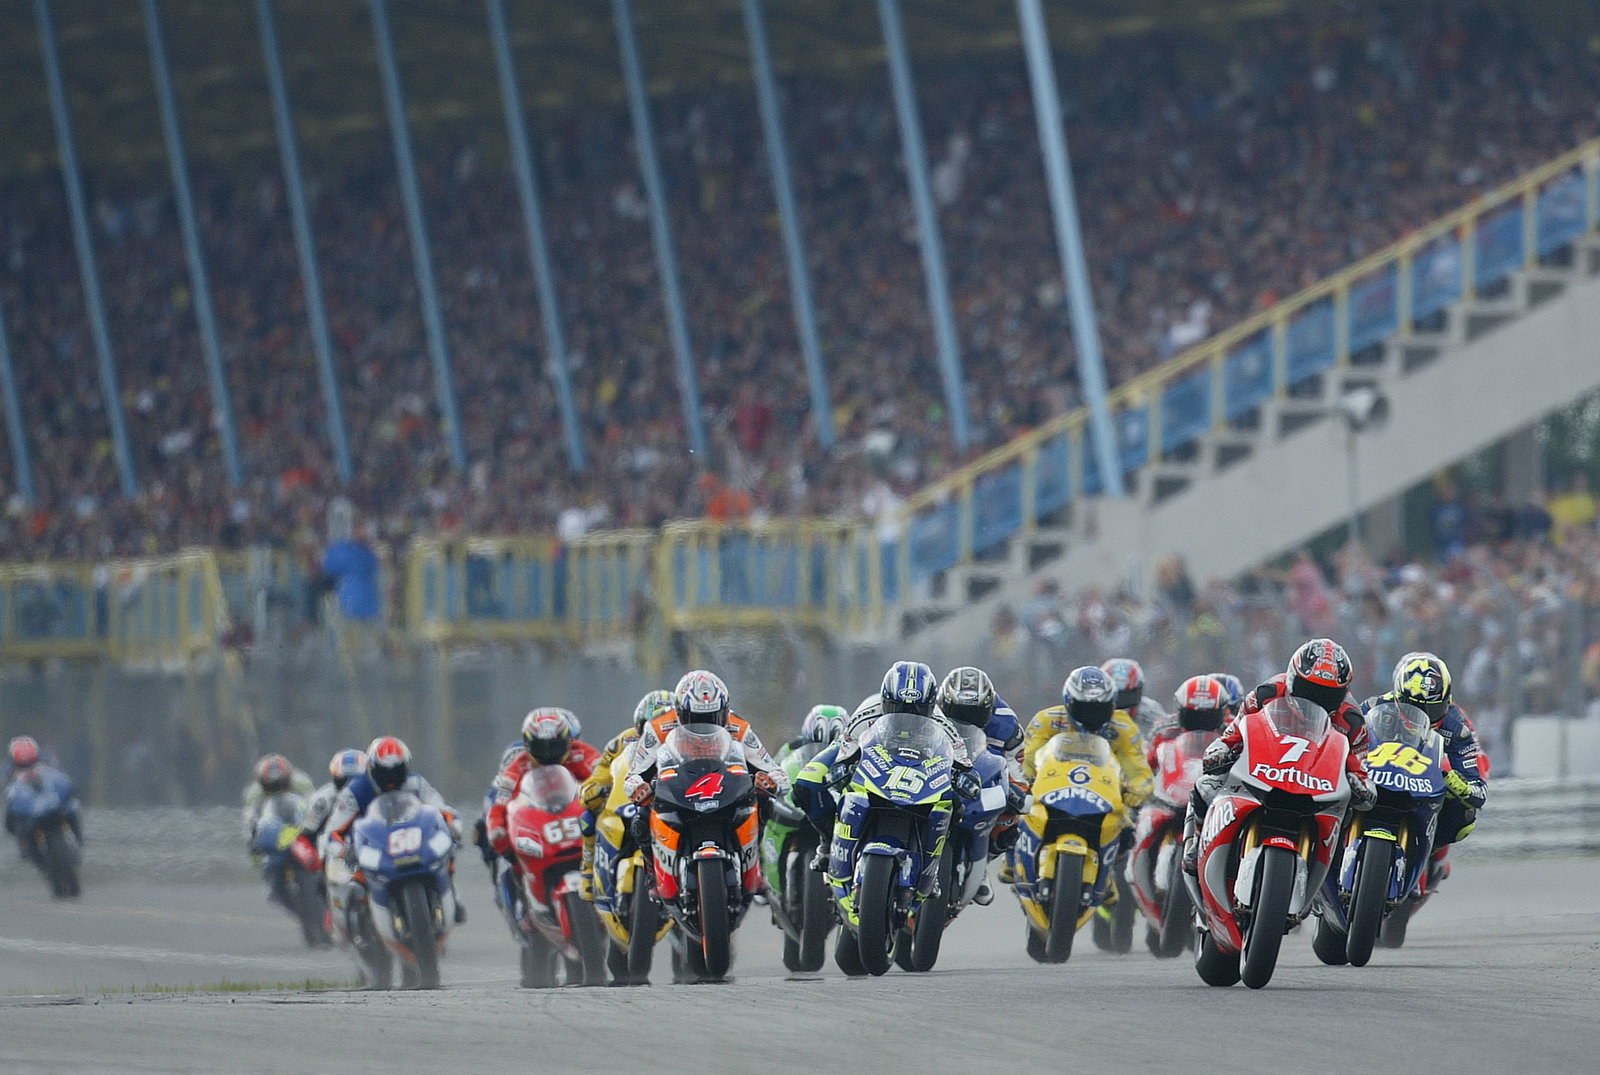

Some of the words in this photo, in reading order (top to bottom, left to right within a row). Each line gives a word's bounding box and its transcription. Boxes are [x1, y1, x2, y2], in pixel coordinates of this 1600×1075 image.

[1279, 735, 1312, 764] 7
[1366, 741, 1433, 775] 46
[684, 772, 725, 800] 4
[881, 765, 929, 795] 15
[1067, 765, 1092, 786] 6
[1250, 763, 1335, 792] Fortuna
[1366, 768, 1434, 794] AULOISES
[1043, 787, 1106, 812] CAMEL
[543, 817, 582, 845] 65
